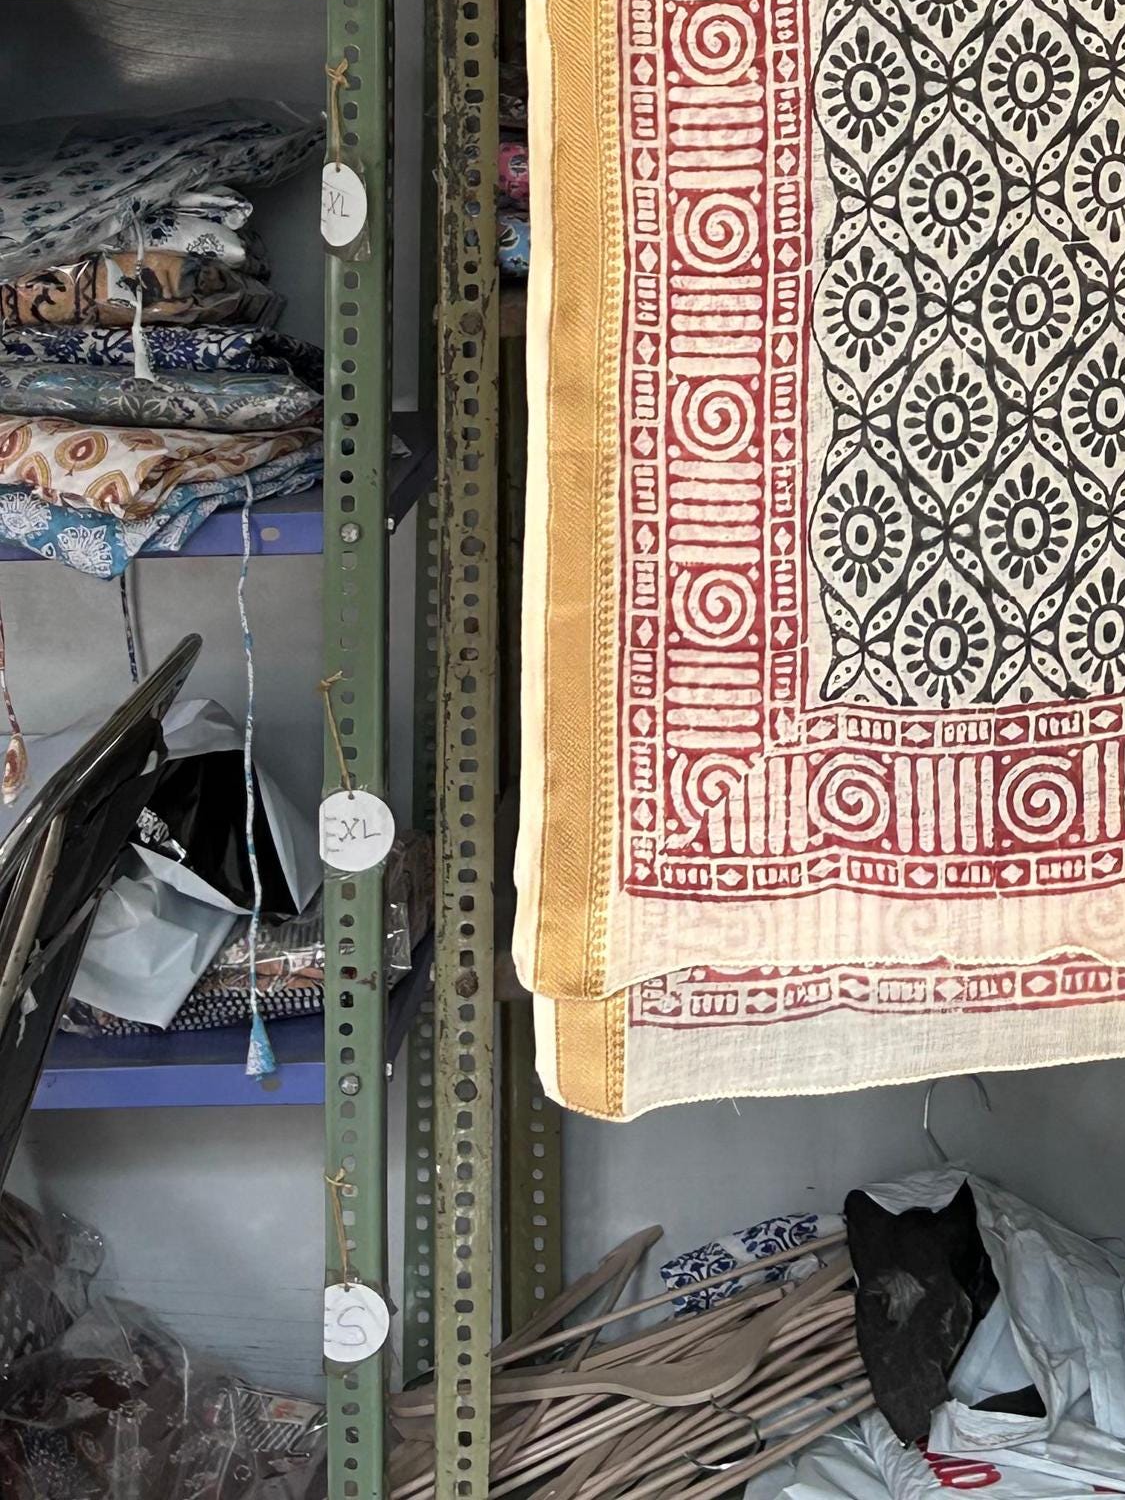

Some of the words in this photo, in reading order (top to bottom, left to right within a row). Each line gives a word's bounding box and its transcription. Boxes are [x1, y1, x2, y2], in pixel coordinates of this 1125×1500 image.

[327, 191, 350, 217] XL
[339, 818, 381, 841] XL
[337, 1305, 367, 1346] S
